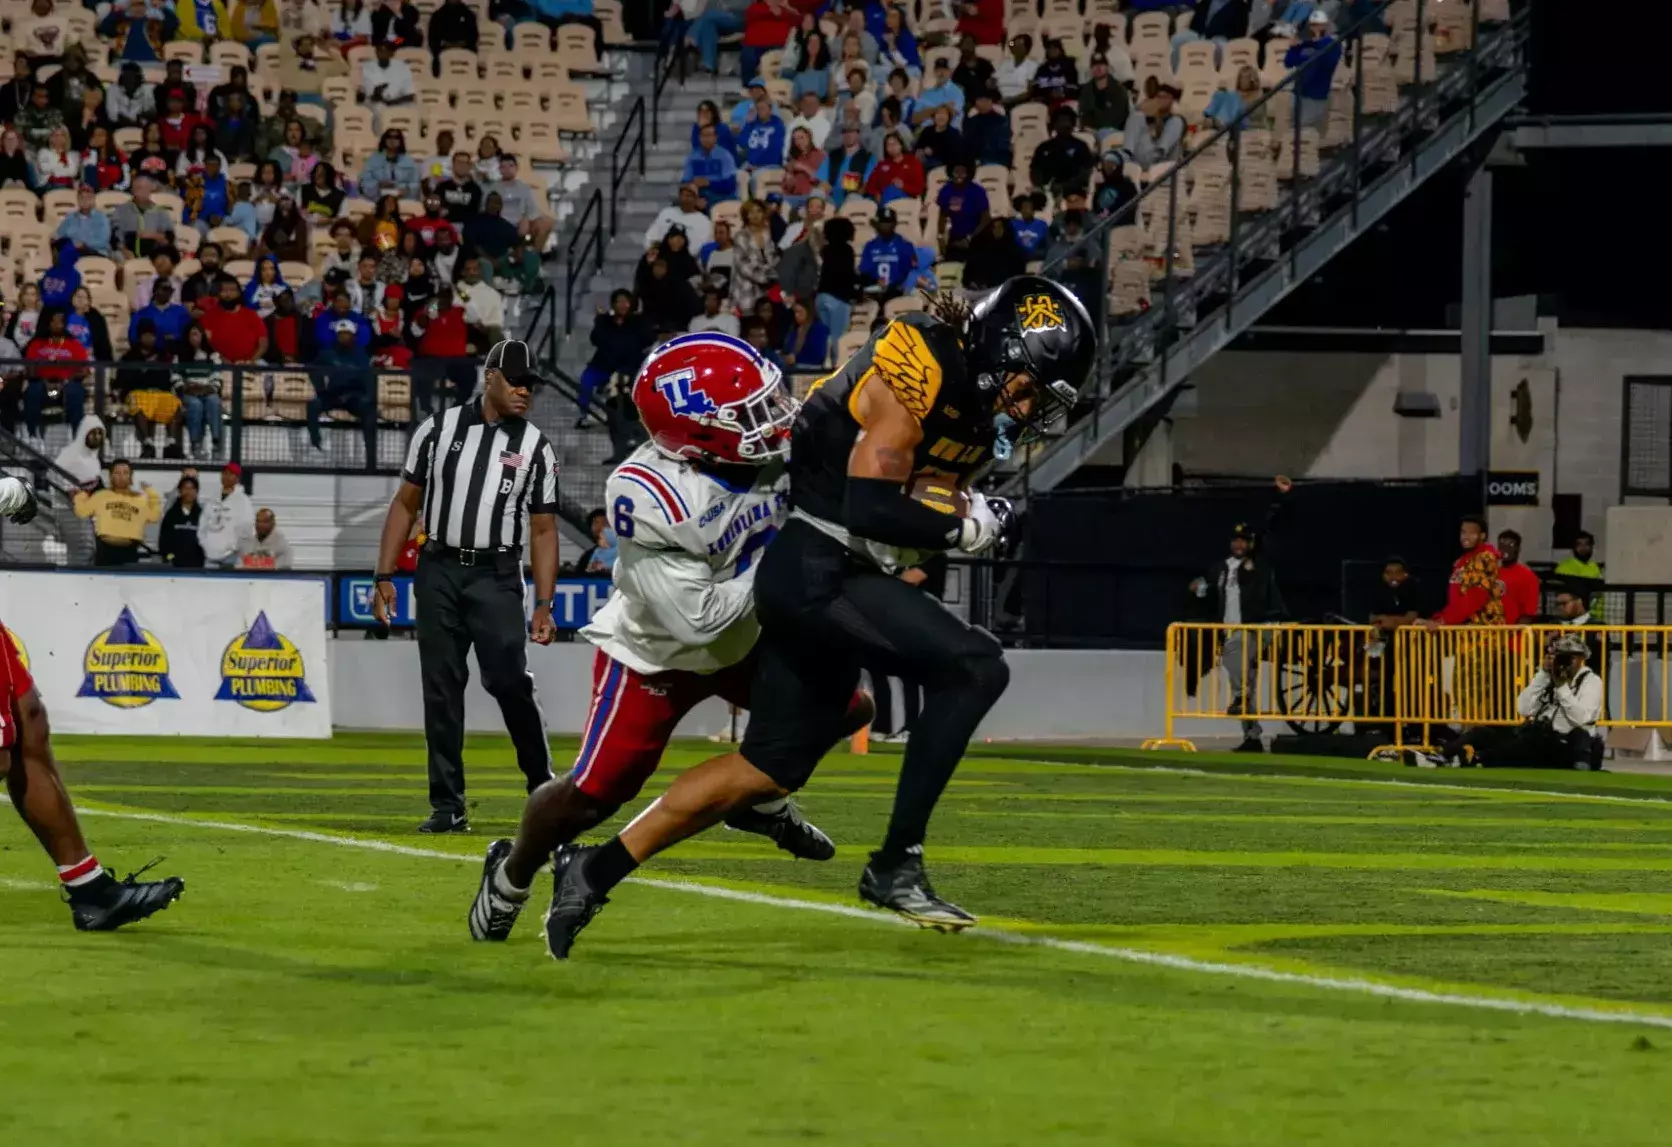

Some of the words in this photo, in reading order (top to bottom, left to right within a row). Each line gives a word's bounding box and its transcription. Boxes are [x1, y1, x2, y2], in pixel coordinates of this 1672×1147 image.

[451, 441, 462, 451] S
[500, 478, 513, 494] B
[1489, 481, 1536, 496] OOMS
[613, 494, 635, 539] 6
[91, 648, 161, 668] Superior
[228, 651, 297, 672] Superior
[94, 673, 161, 693] PLUMBING
[231, 677, 297, 697] PLUMBING
